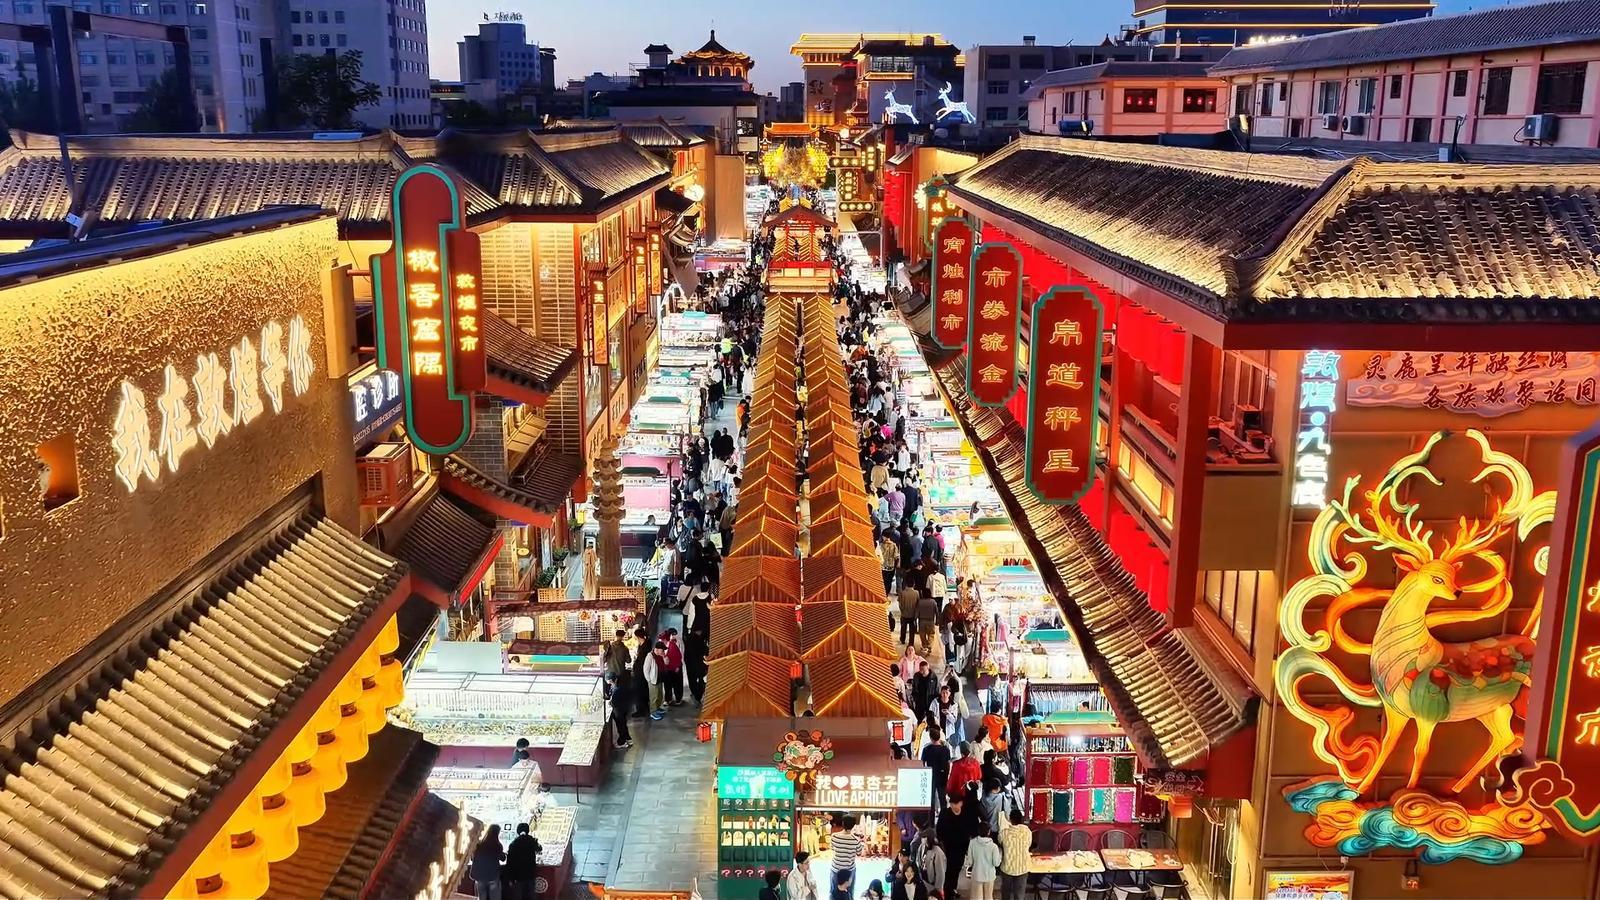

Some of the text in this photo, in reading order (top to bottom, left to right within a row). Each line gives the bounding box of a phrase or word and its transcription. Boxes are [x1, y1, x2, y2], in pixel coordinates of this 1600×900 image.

[456, 273, 479, 352] 敦煌夜市
[941, 237, 965, 331] 宵烛利市
[979, 266, 1011, 384] 市券流金
[1042, 318, 1084, 474] 帛道秤星
[815, 790, 898, 807] I LOVE APRICOT
